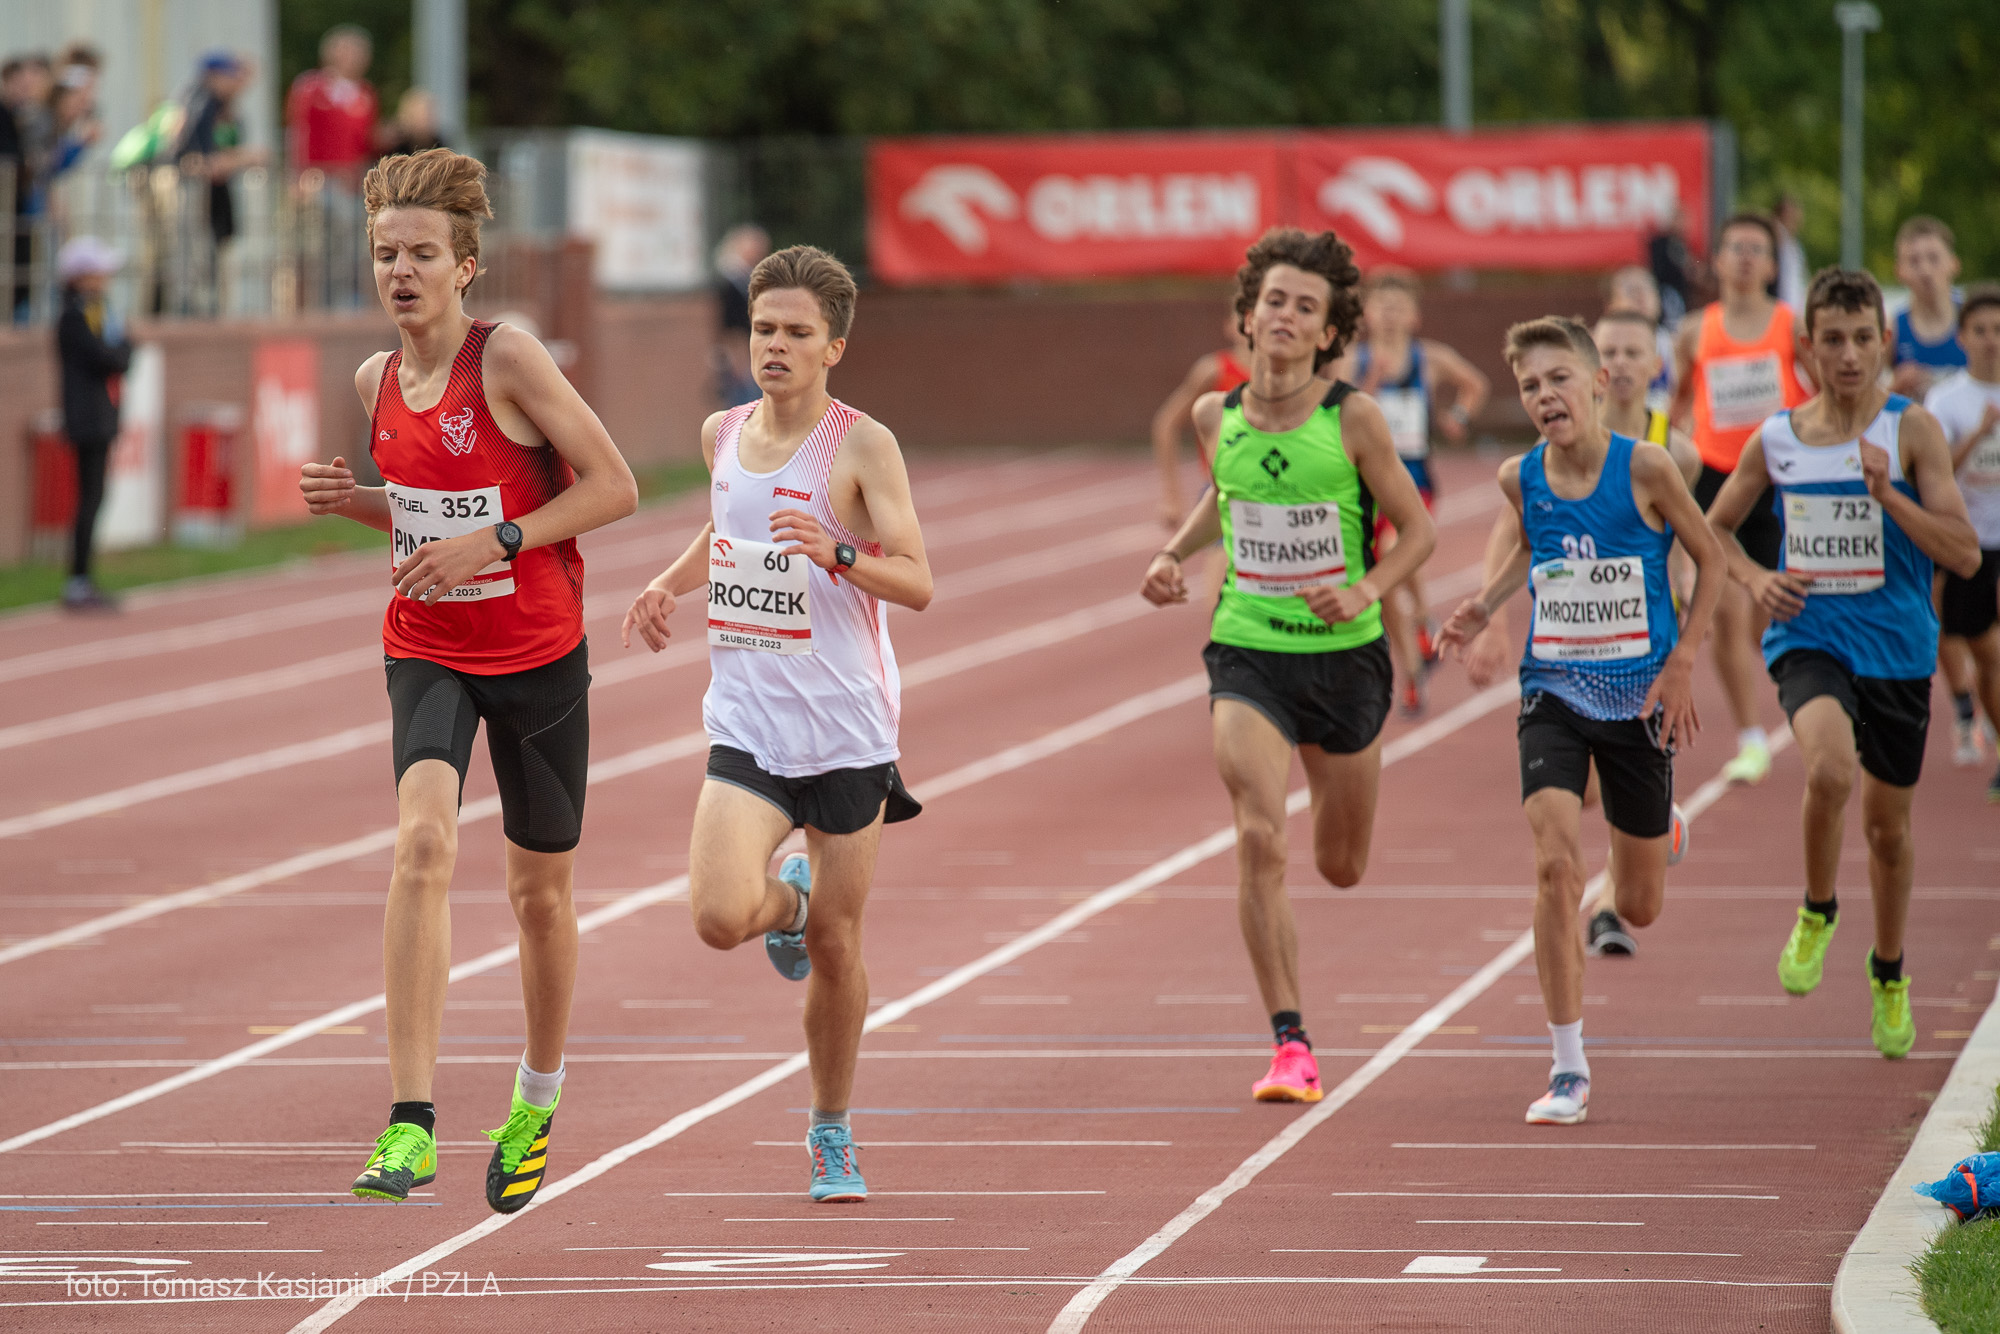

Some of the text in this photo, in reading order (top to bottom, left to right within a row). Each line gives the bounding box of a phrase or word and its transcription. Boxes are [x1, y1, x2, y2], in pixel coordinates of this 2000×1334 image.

[1026, 172, 1261, 242] ORLEN
[1445, 162, 1680, 234] ORLEN
[397, 495, 490, 519] FUEL 352
[1288, 508, 1328, 528] 389
[1832, 501, 1872, 521] 732
[1238, 536, 1338, 564] STEFAŃSKI
[711, 558, 736, 569] ORLEN
[763, 550, 790, 573] 60
[1590, 563, 1632, 584] 609
[455, 587, 482, 597] 2023
[1539, 598, 1642, 624] MROZIEWICZ
[719, 633, 782, 650] SŁUBICE 2023
